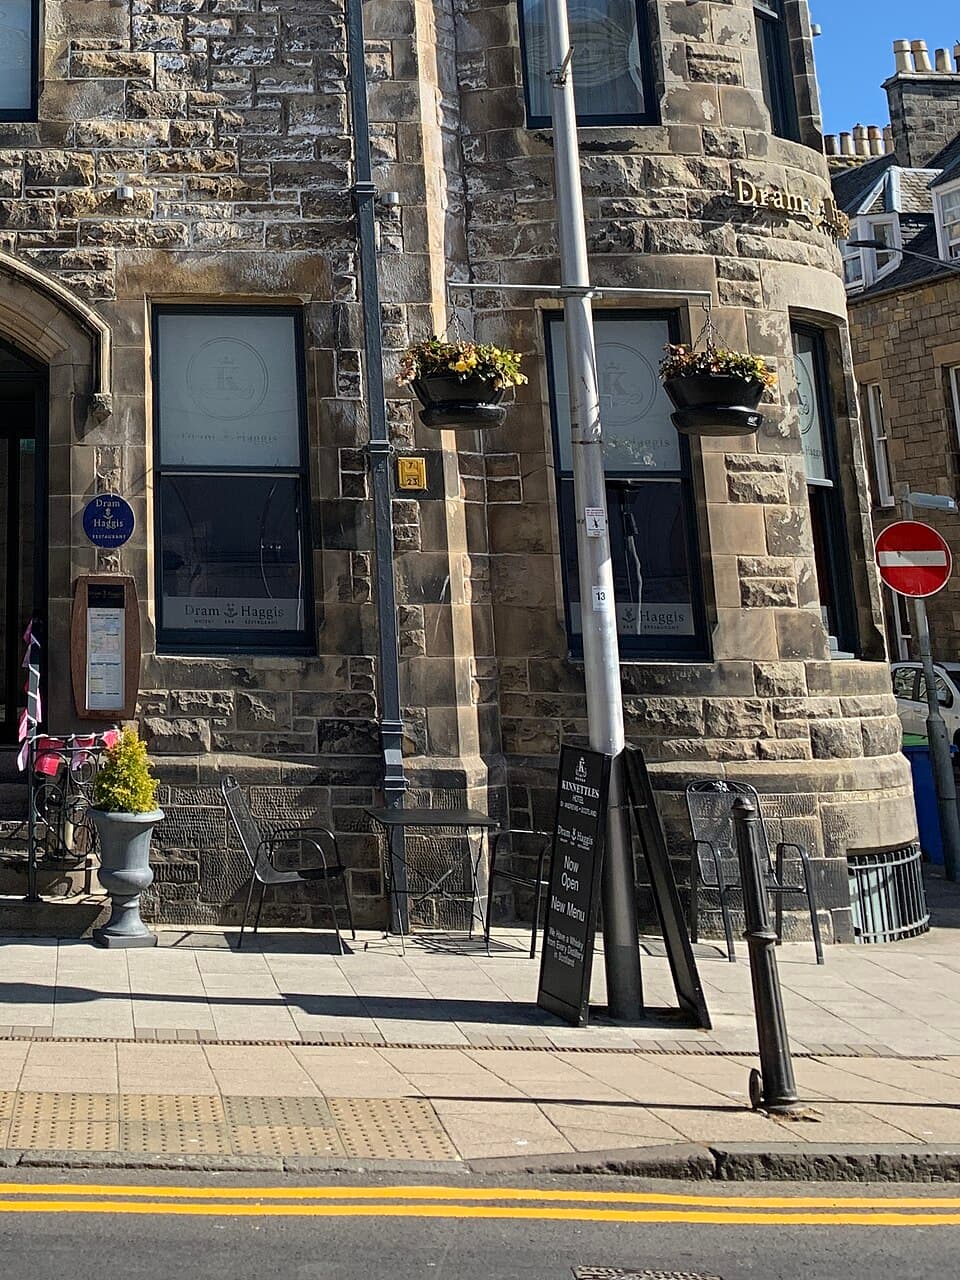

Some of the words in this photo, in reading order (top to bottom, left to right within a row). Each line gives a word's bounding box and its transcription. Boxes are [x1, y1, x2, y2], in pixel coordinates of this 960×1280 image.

[736, 178, 805, 212] Dram
[406, 477, 418, 486] 23
[95, 499, 121, 508] Dram
[93, 518, 124, 530] Haggis
[595, 591, 606, 601] 13
[185, 604, 219, 616] Dram
[241, 606, 284, 620] Haggis
[640, 610, 685, 625] Haggis
[561, 780, 600, 799] KINNETTLES
[563, 855, 579, 873] Now
[561, 872, 579, 892] Open
[551, 895, 566, 913] New
[566, 902, 585, 922] Menu
